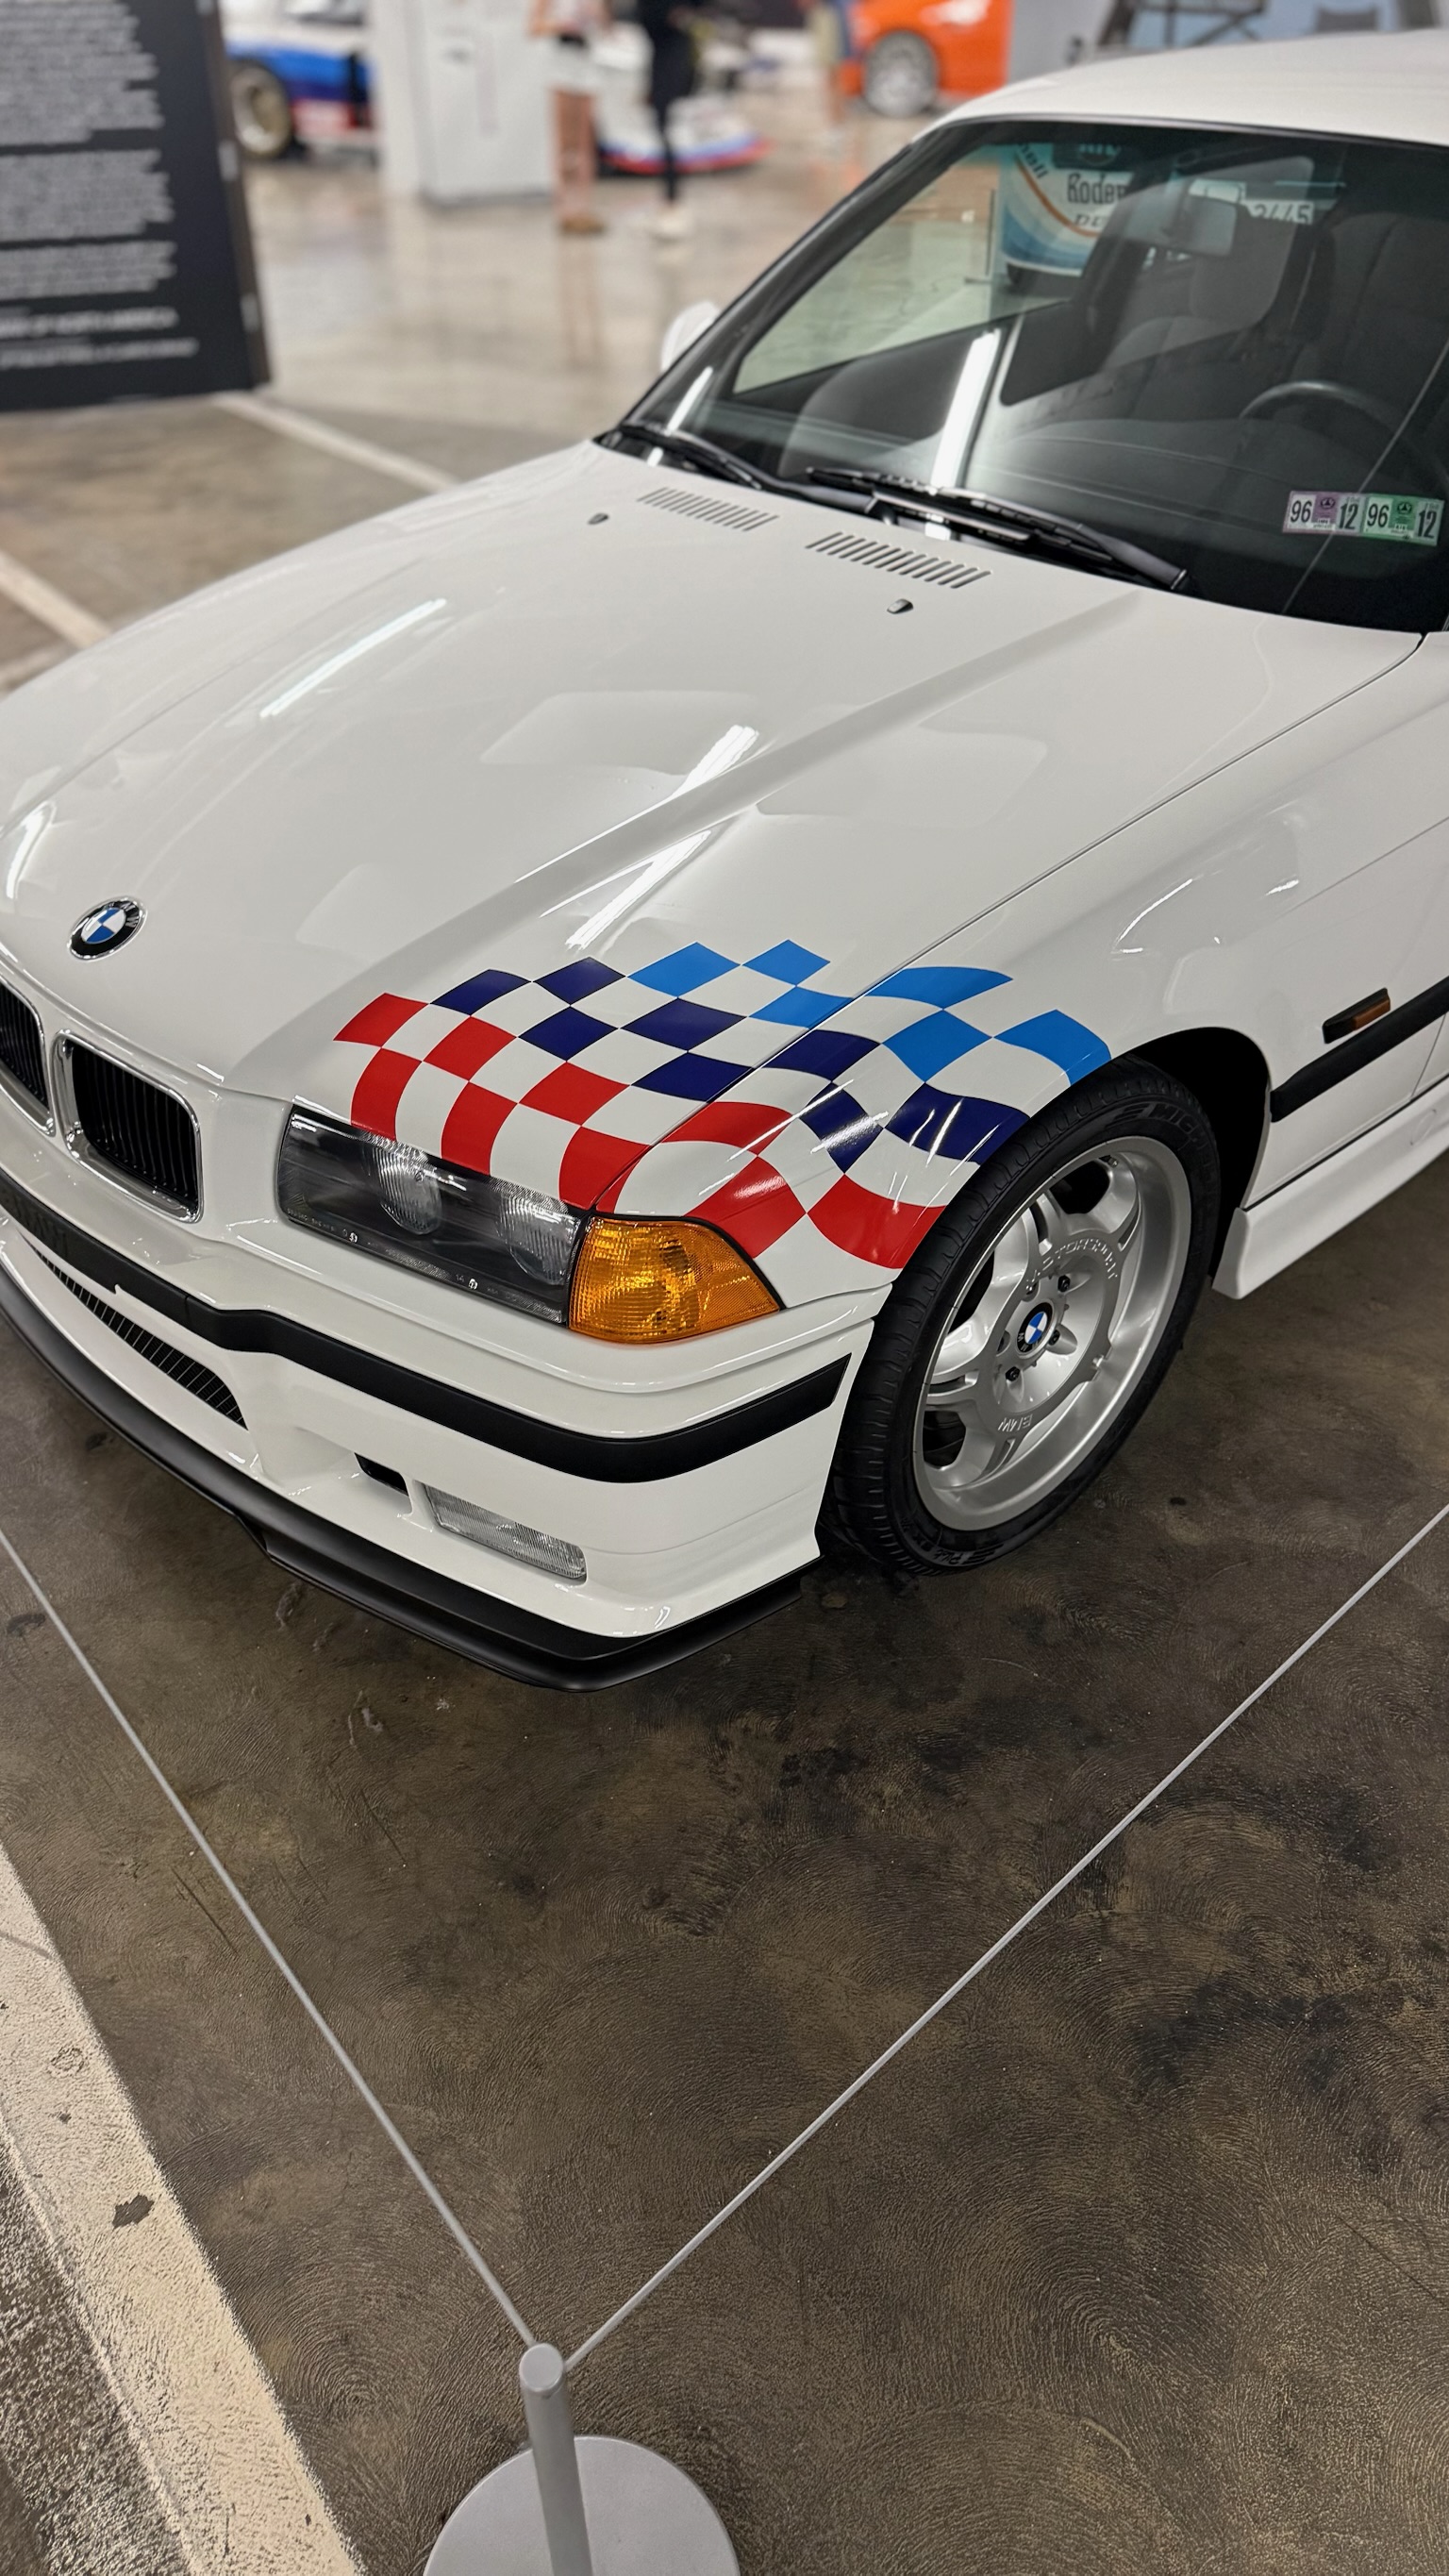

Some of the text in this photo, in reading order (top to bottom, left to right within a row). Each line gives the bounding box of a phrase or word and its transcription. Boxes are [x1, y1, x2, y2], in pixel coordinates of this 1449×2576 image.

[1290, 499, 1313, 523] 96
[1338, 502, 1359, 530] 12
[1366, 503, 1390, 528] 96
[1417, 509, 1438, 539] 12
[997, 1413, 1034, 1432] BMW
